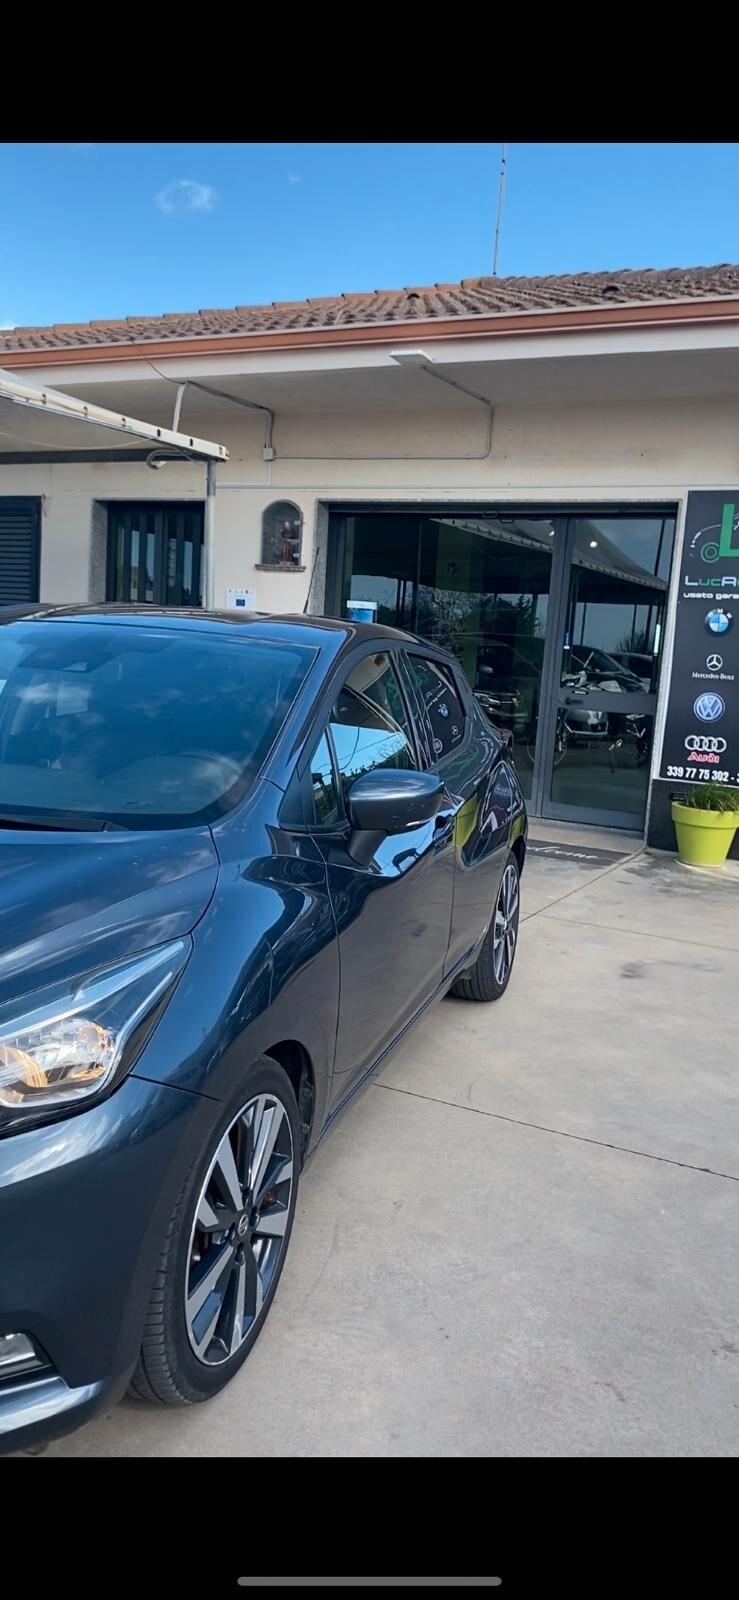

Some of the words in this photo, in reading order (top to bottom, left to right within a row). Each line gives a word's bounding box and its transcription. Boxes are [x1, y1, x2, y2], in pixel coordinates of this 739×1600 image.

[685, 575, 739, 588] LucA
[683, 592, 714, 600] usato
[667, 765, 684, 778] 339
[685, 767, 697, 779] 77
[698, 768, 710, 780] 75
[711, 770, 729, 782] 302
